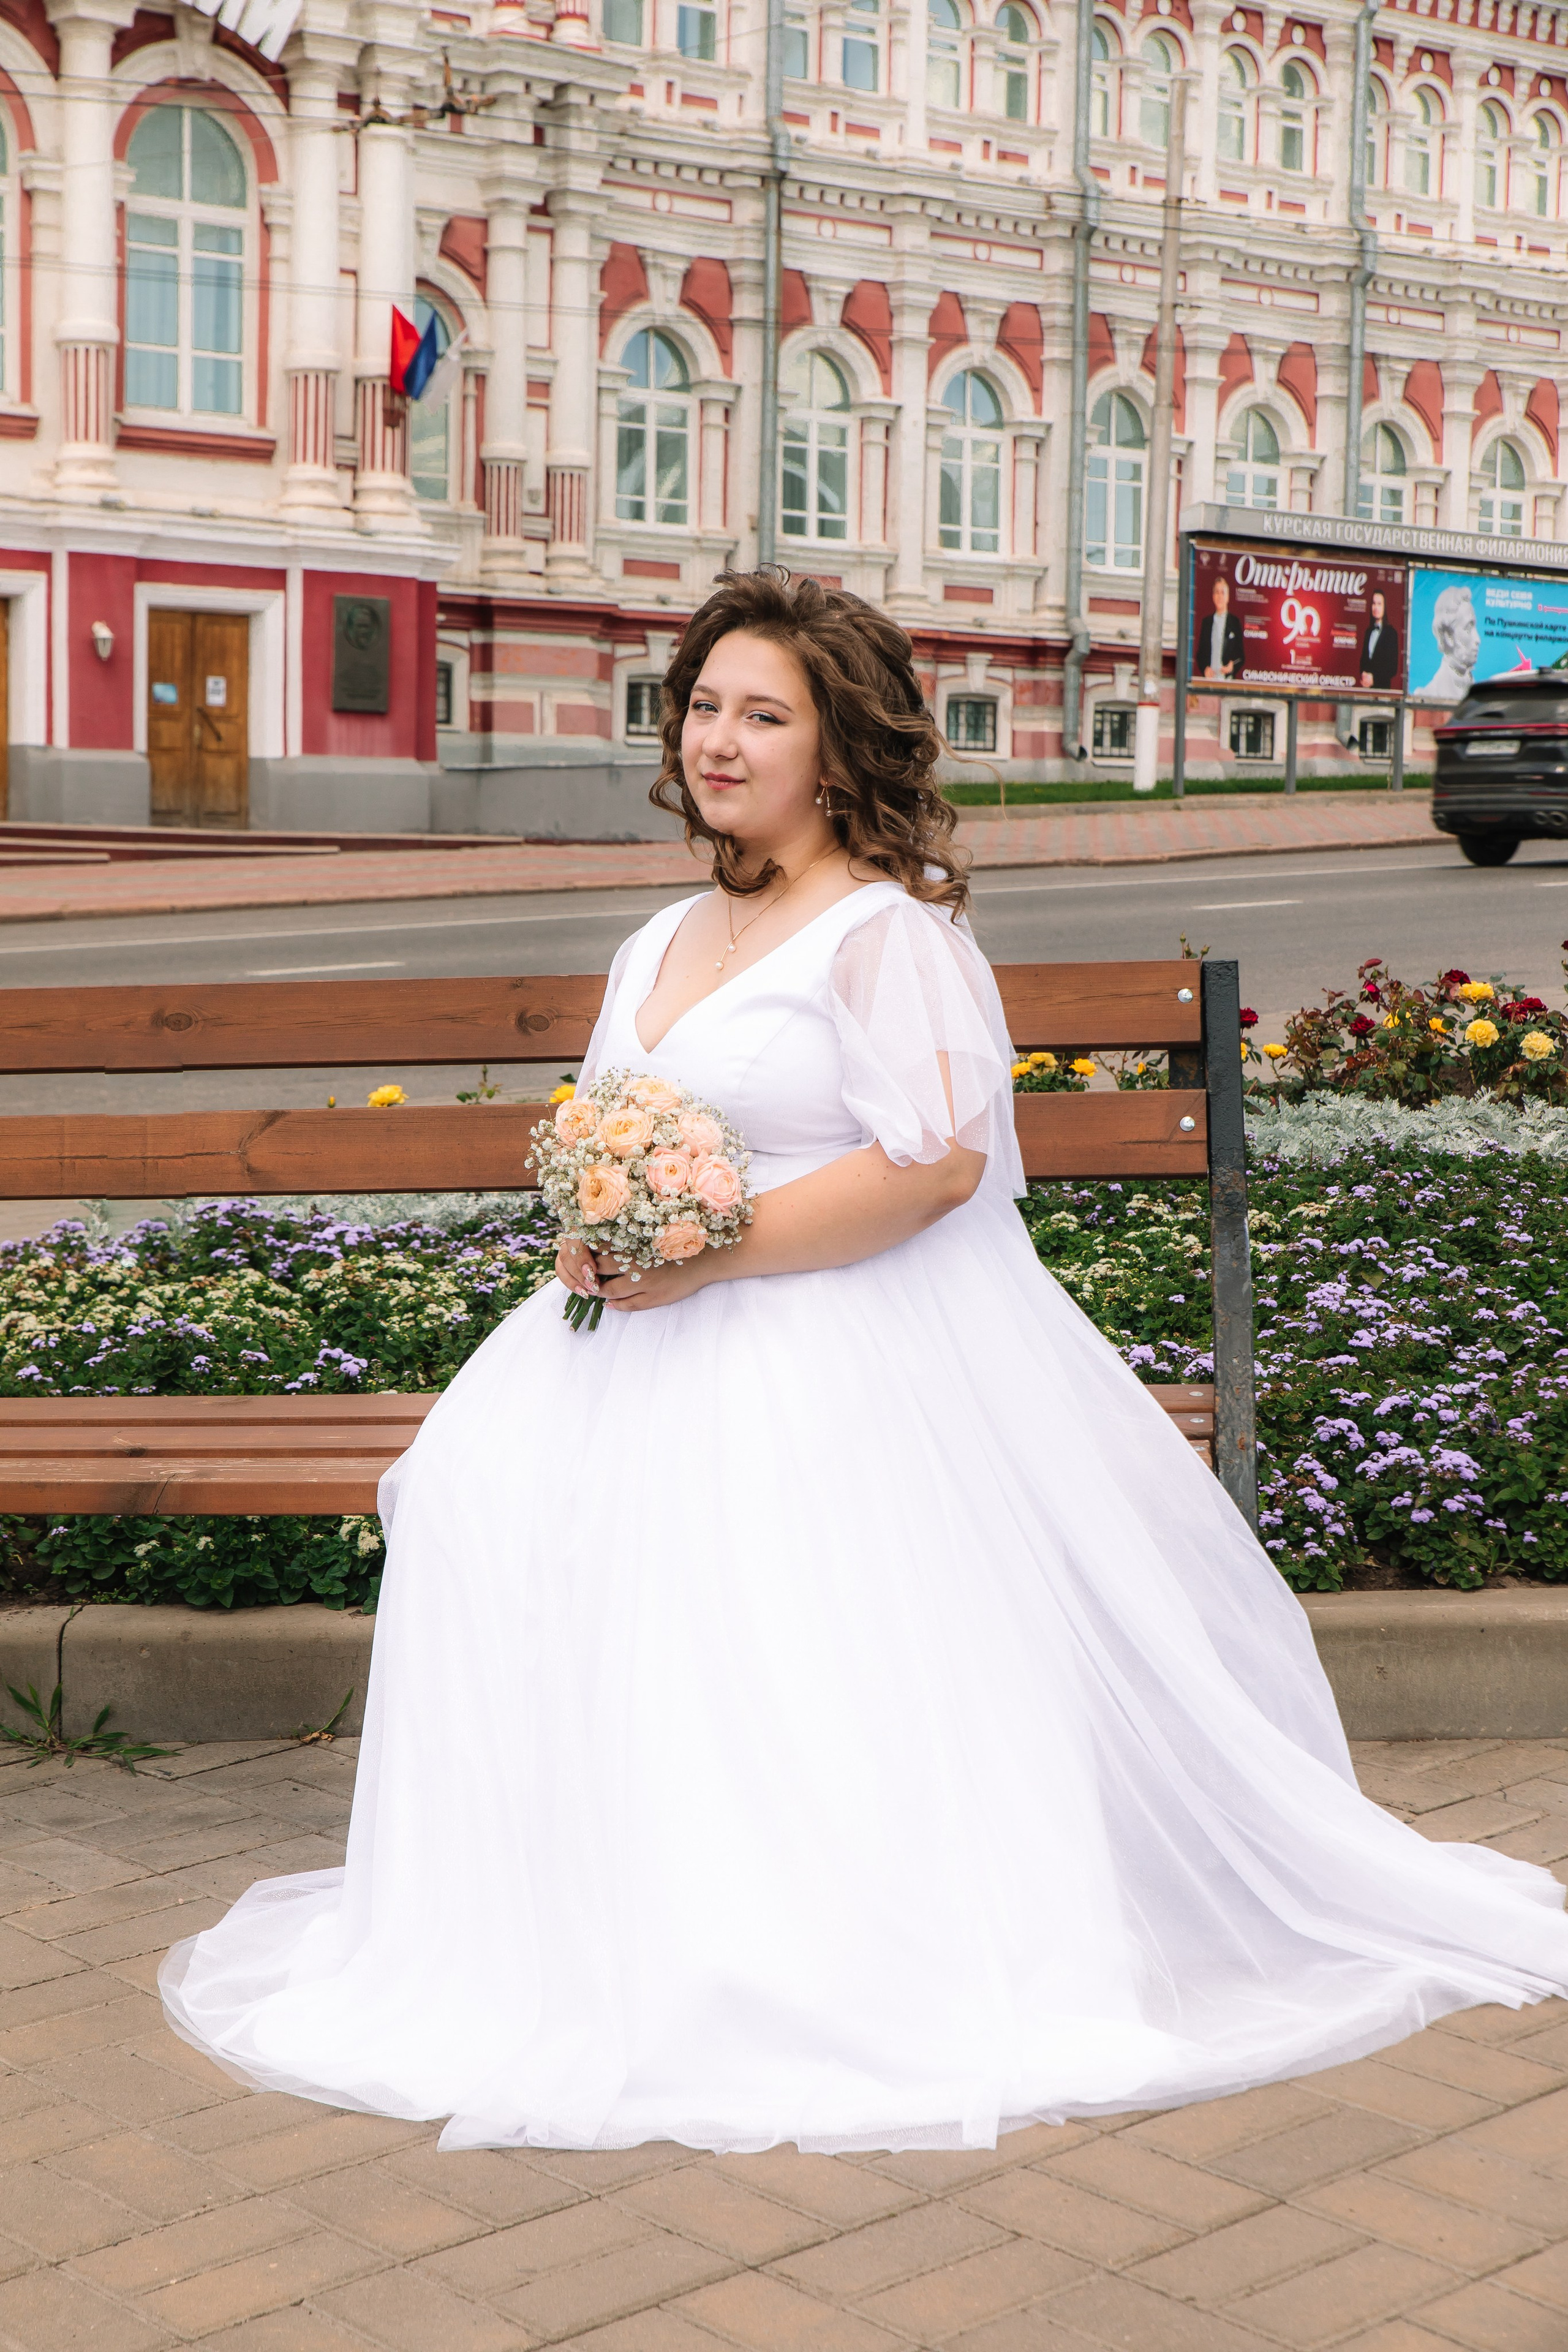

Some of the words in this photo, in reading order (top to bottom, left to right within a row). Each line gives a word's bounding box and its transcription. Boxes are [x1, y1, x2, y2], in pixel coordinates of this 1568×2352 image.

[1263, 513, 1332, 539] КУРСКАЯ
[1335, 522, 1473, 554] ГОСУДАРСТВЕННАЯ
[1234, 554, 1368, 596] Открытие
[1243, 669, 1319, 685] СИМФОНИЧЕСКИЙ
[1319, 674, 1356, 687] ОРКЕСТР
